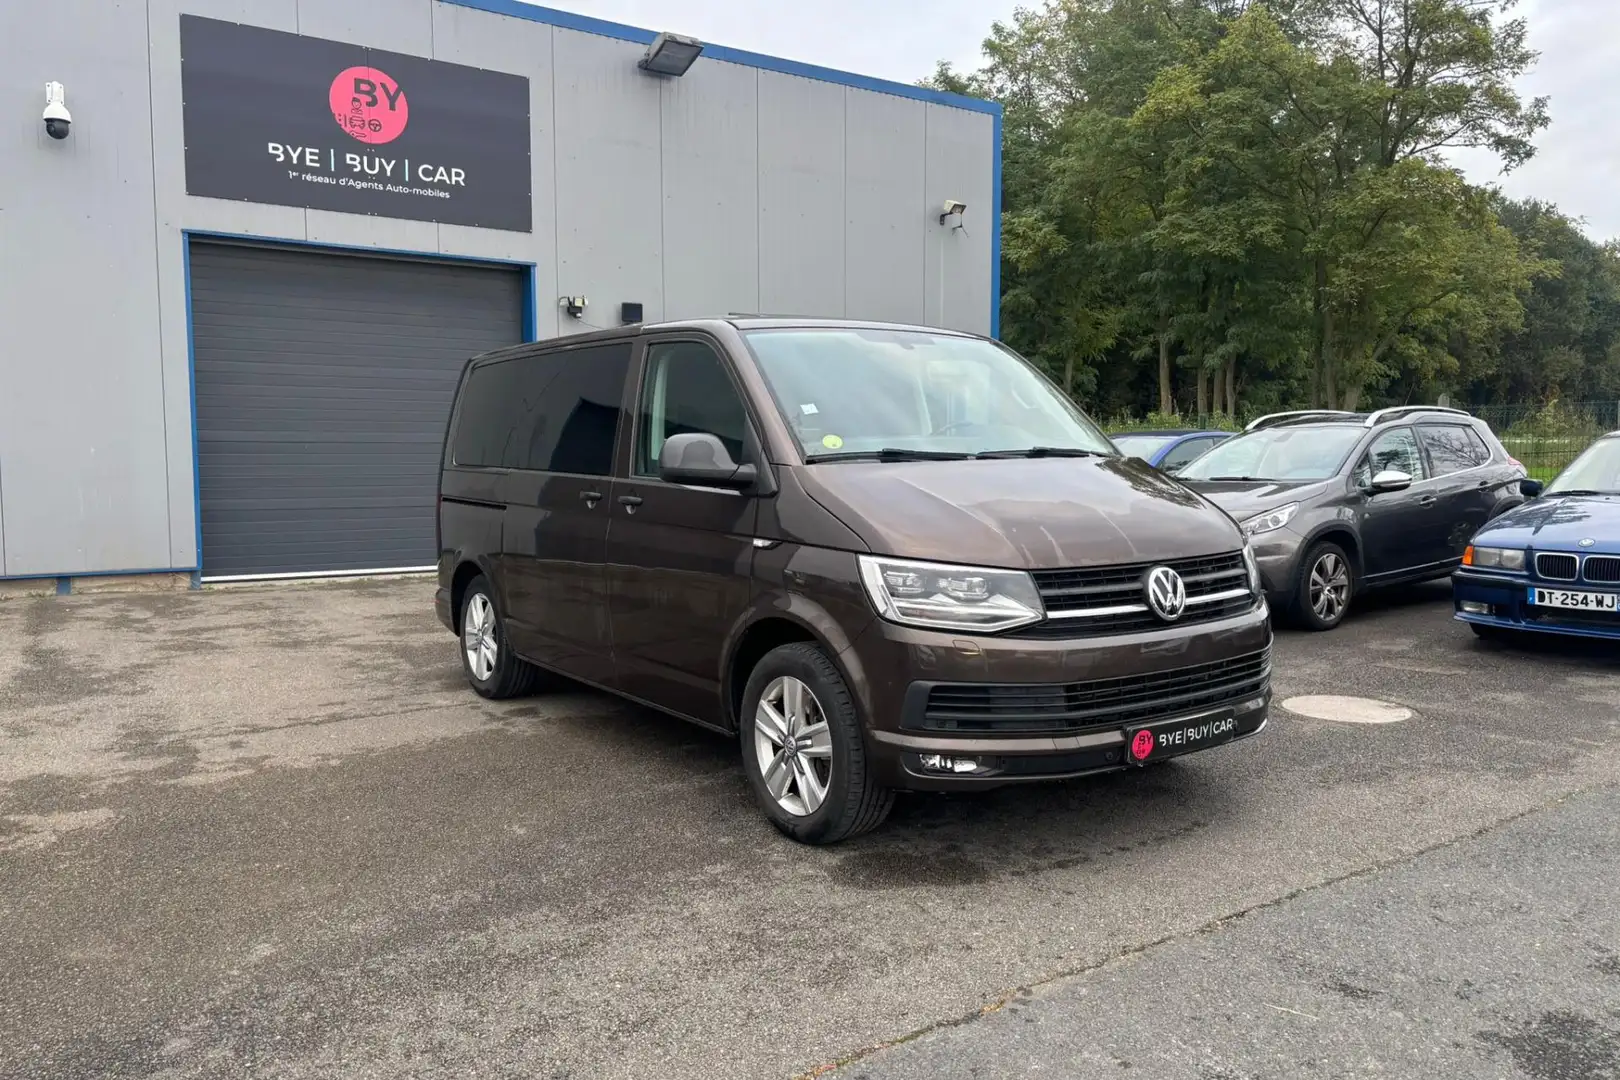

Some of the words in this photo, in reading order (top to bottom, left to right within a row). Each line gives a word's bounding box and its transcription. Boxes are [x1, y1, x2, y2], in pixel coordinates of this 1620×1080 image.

[354, 77, 402, 111] BY
[268, 142, 320, 167] BYE
[345, 152, 396, 177] BUY
[418, 164, 465, 187] CAR
[302, 172, 336, 184] réseau
[339, 177, 383, 191] d'Agents
[386, 183, 450, 199] Auto-mobiles
[1537, 590, 1615, 609] DT-254-WJ
